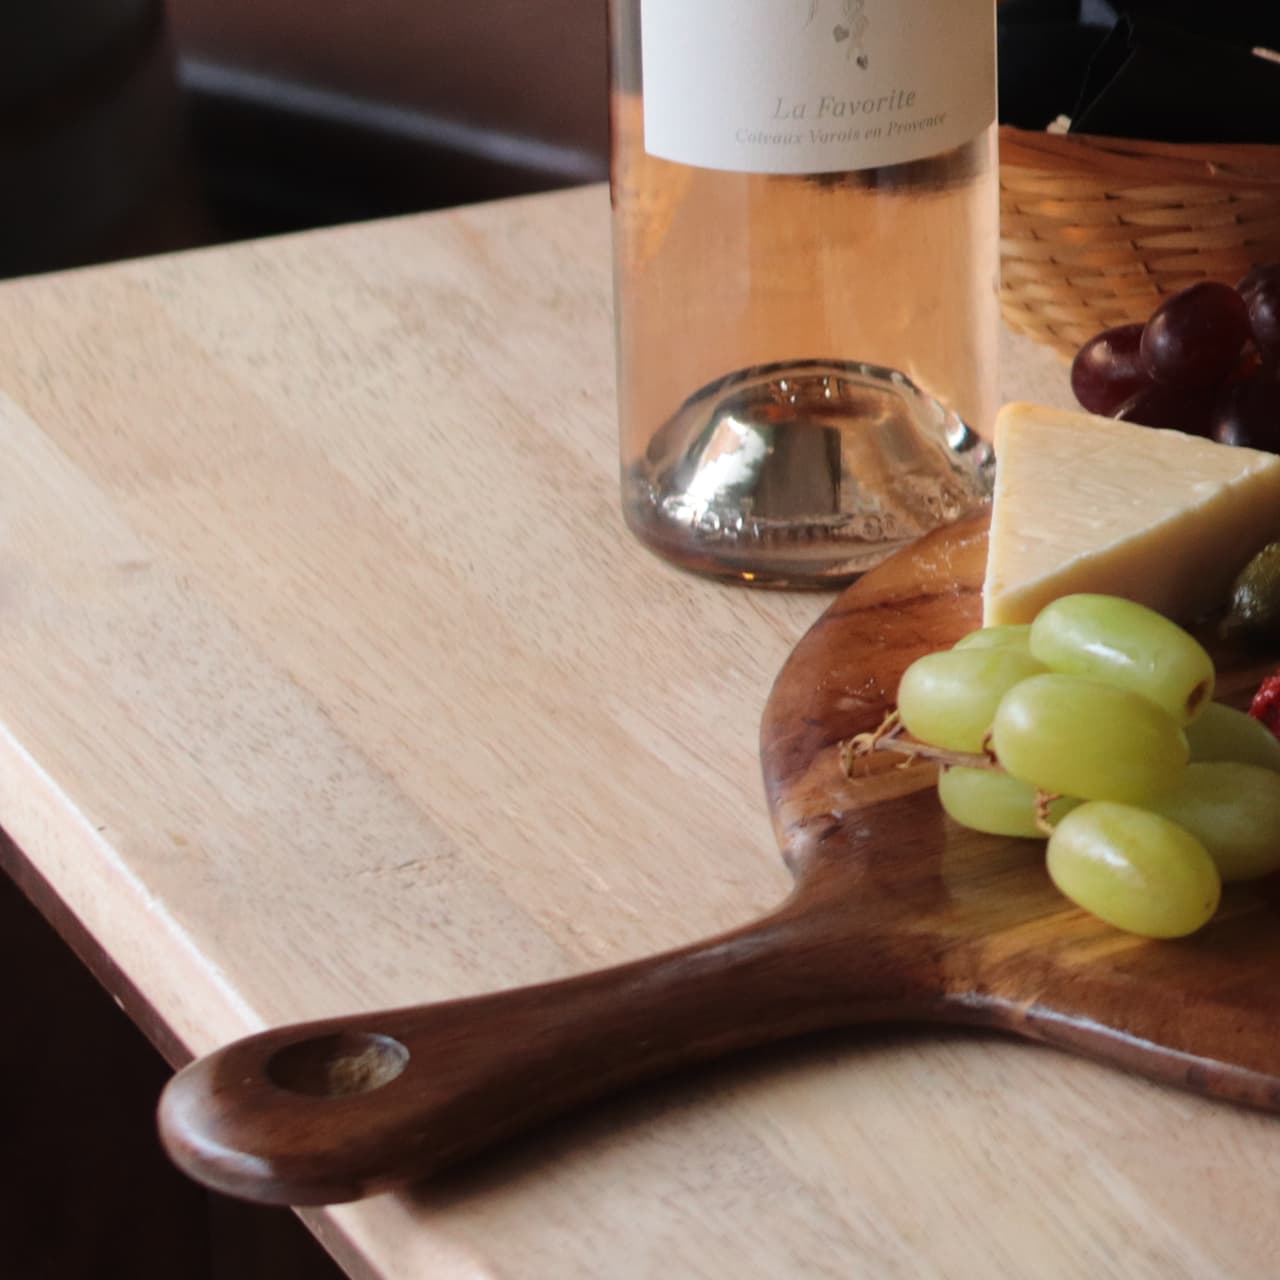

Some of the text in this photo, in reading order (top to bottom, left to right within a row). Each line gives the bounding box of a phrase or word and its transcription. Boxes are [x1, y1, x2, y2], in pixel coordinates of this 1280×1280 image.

[773, 87, 917, 121] La Favorite
[735, 111, 947, 146] Coteaux Varois en Provence
